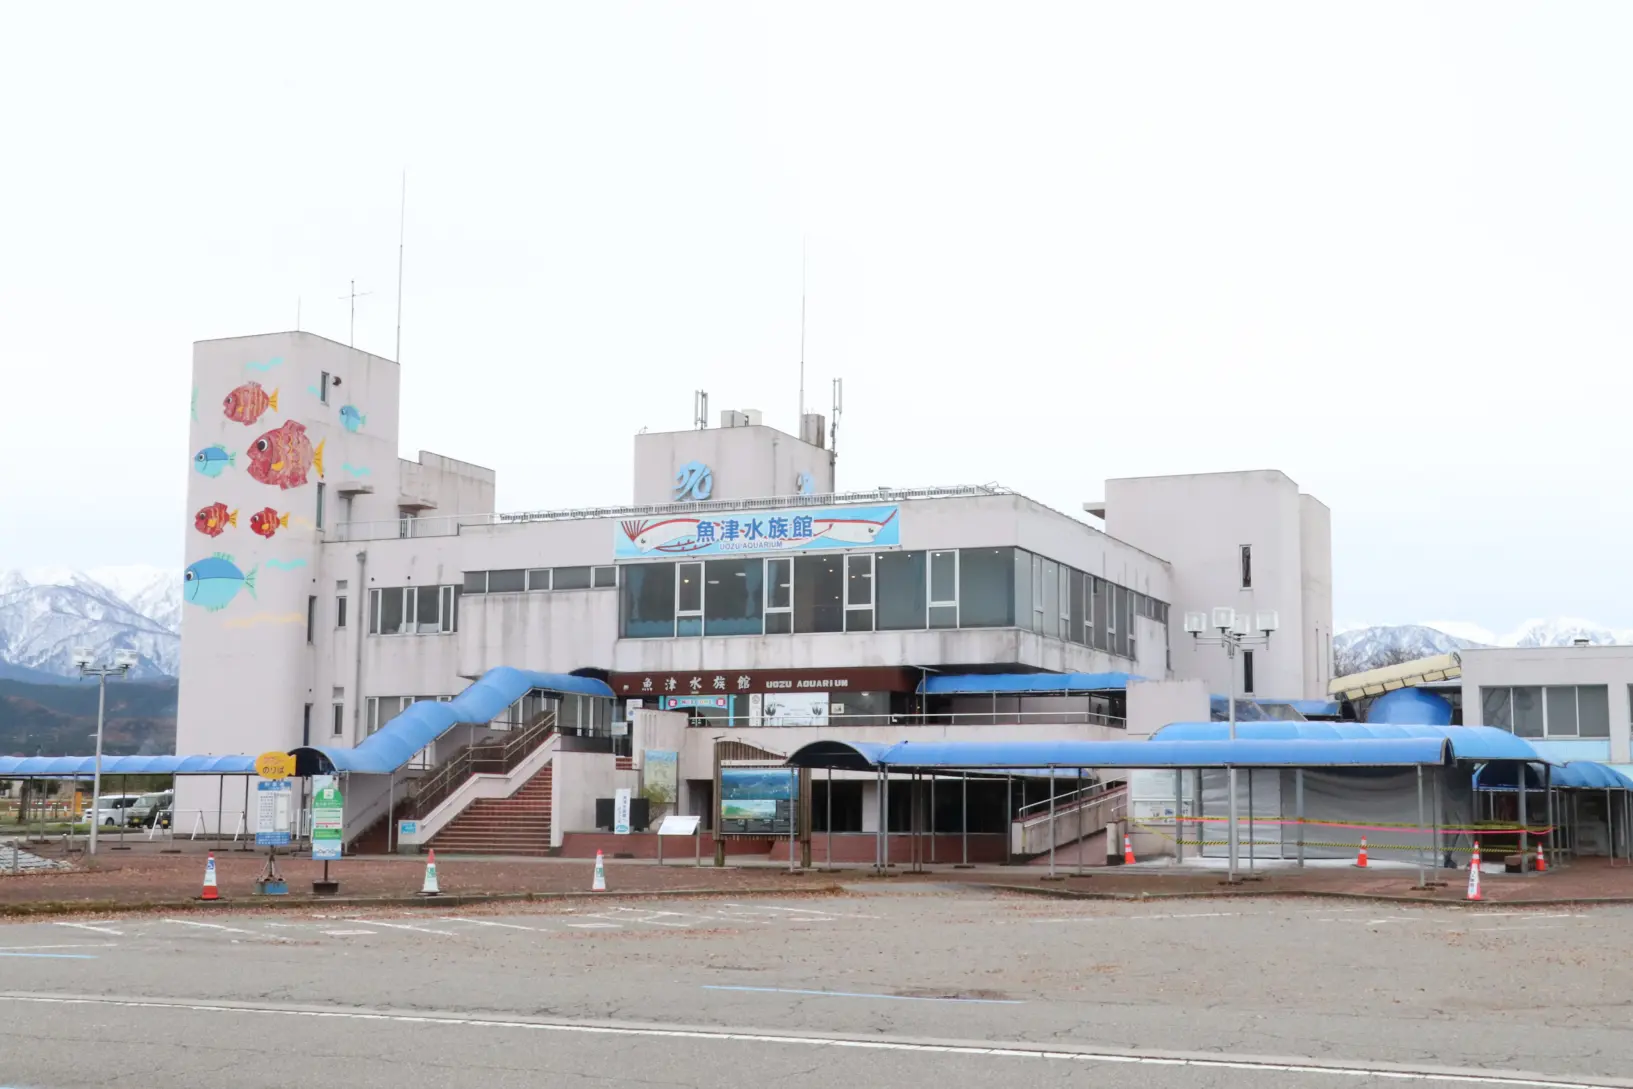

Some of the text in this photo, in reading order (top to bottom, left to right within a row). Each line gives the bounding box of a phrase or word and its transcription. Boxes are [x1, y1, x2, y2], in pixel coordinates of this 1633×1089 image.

[696, 515, 813, 543] 魚津水族館
[743, 541, 783, 549] AQUARIUM
[642, 675, 751, 690] 魚津水族館
[765, 679, 848, 688] UOZU AQUARIUM
[262, 765, 285, 774] のりば
